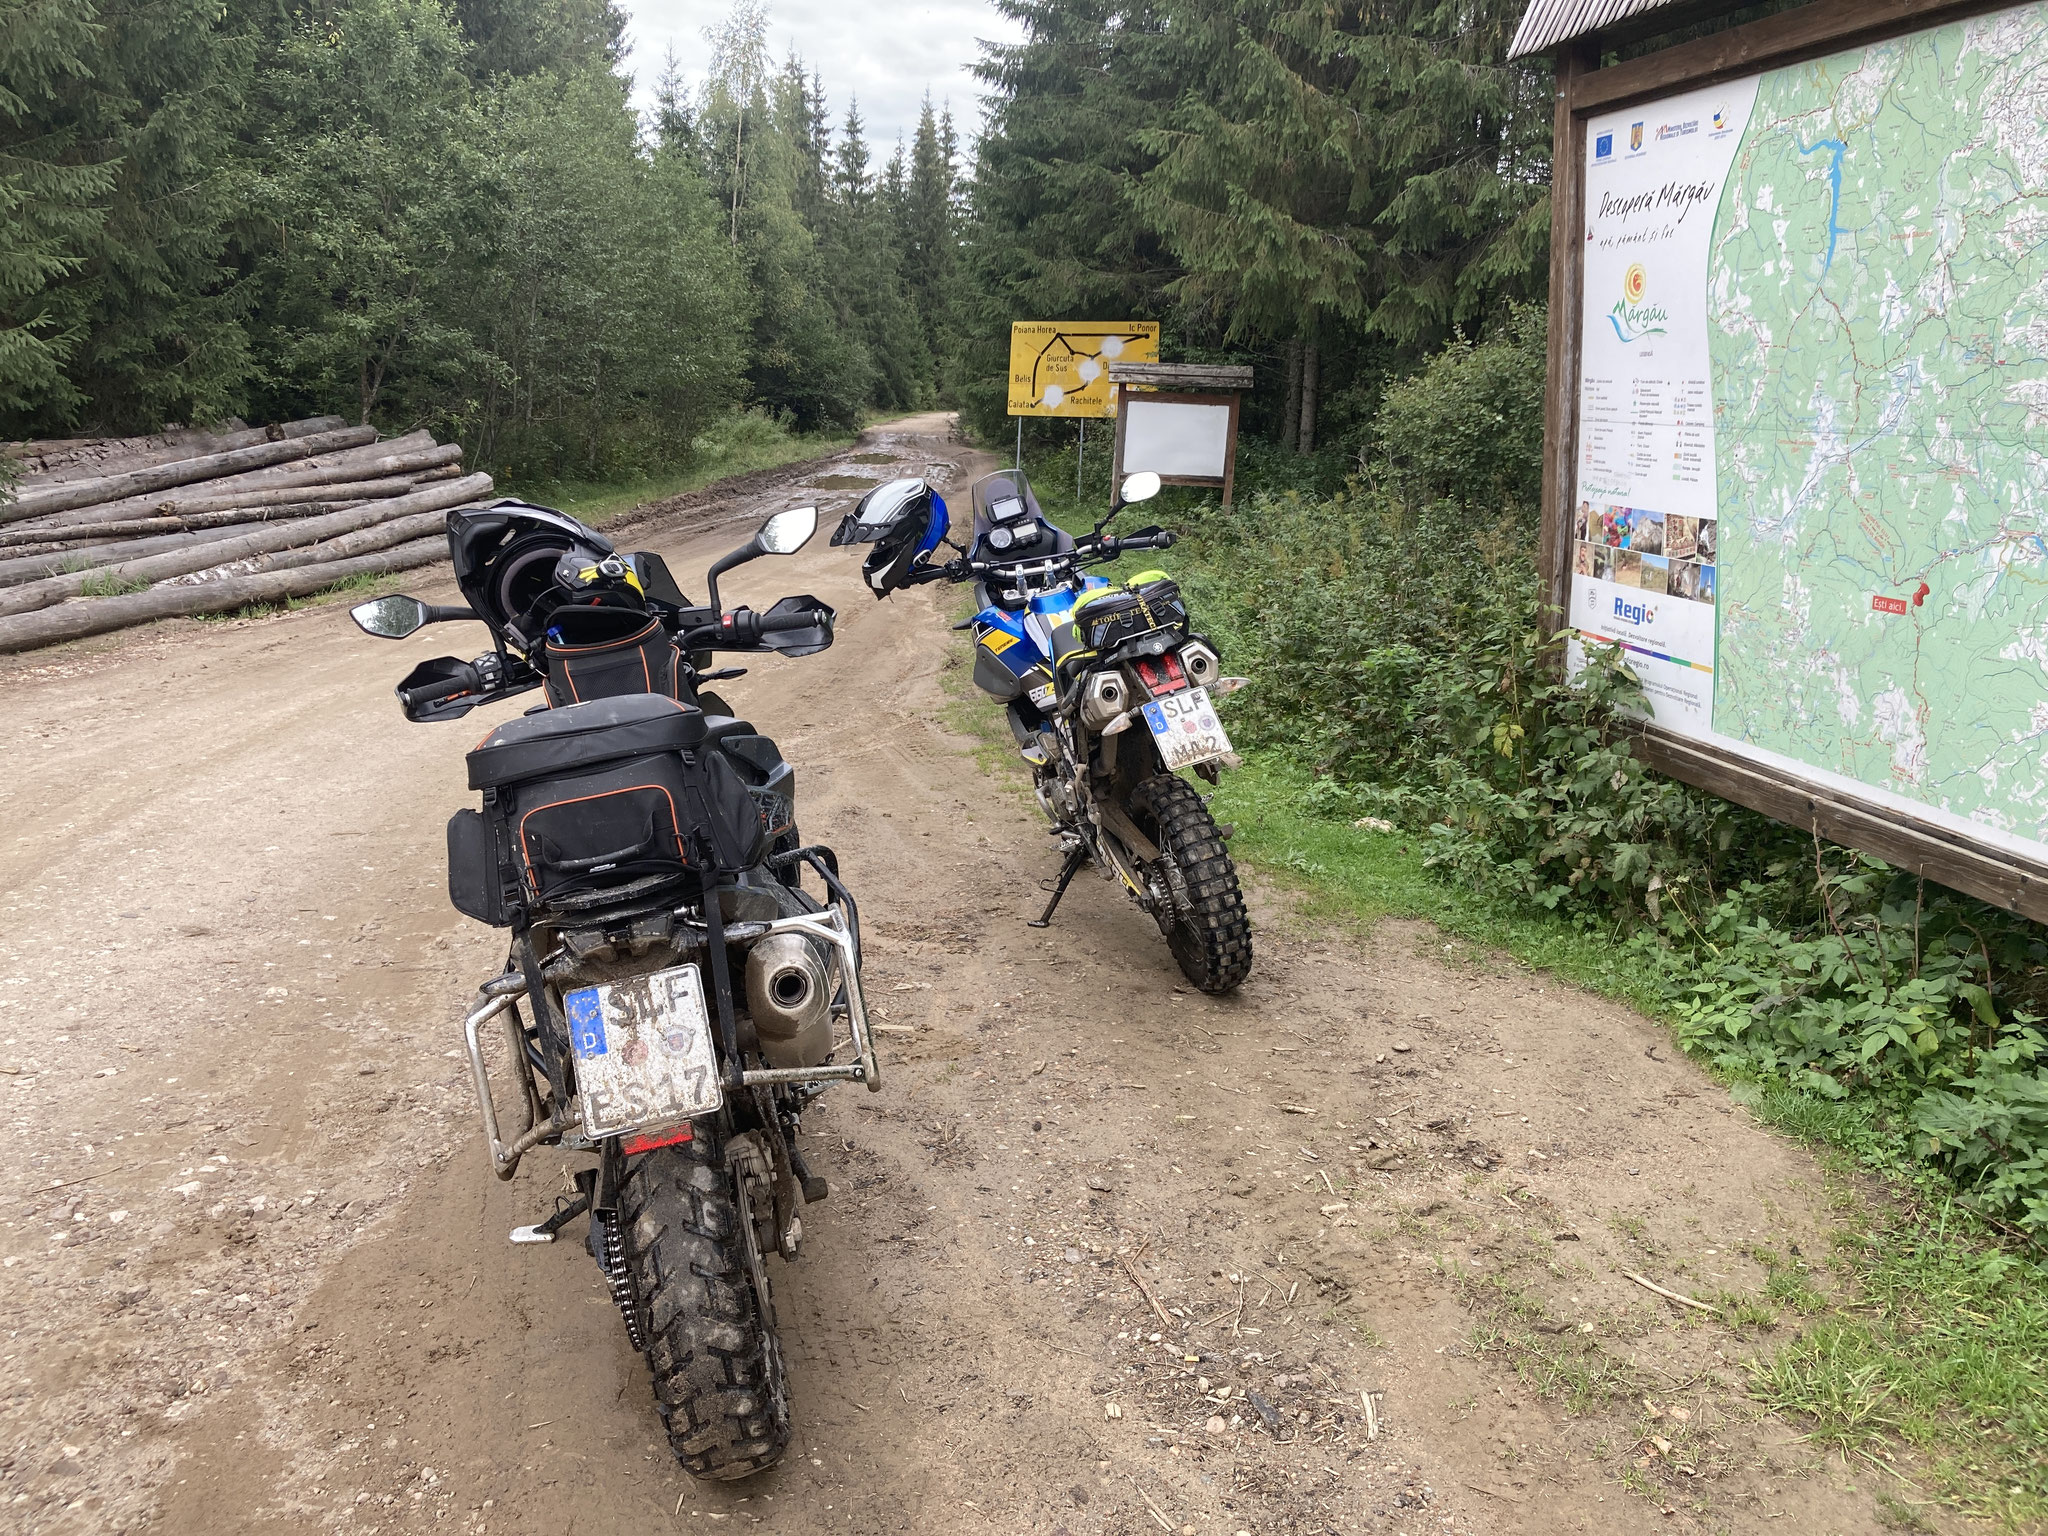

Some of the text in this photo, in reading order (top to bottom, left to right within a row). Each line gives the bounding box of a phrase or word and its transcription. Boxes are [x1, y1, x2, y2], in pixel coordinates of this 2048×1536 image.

[1014, 325, 1057, 334] Poiana Horea
[1137, 323, 1157, 332] Ponor
[1046, 354, 1074, 363] Giurcuta
[1055, 364, 1068, 372] Sus
[1014, 374, 1031, 383] Belis
[1070, 396, 1103, 406] Rachitele
[1614, 597, 1655, 626] Regio
[1163, 690, 1204, 718] SLF
[1155, 721, 1164, 730] D
[607, 971, 690, 1028] SLF
[583, 1032, 597, 1050] D
